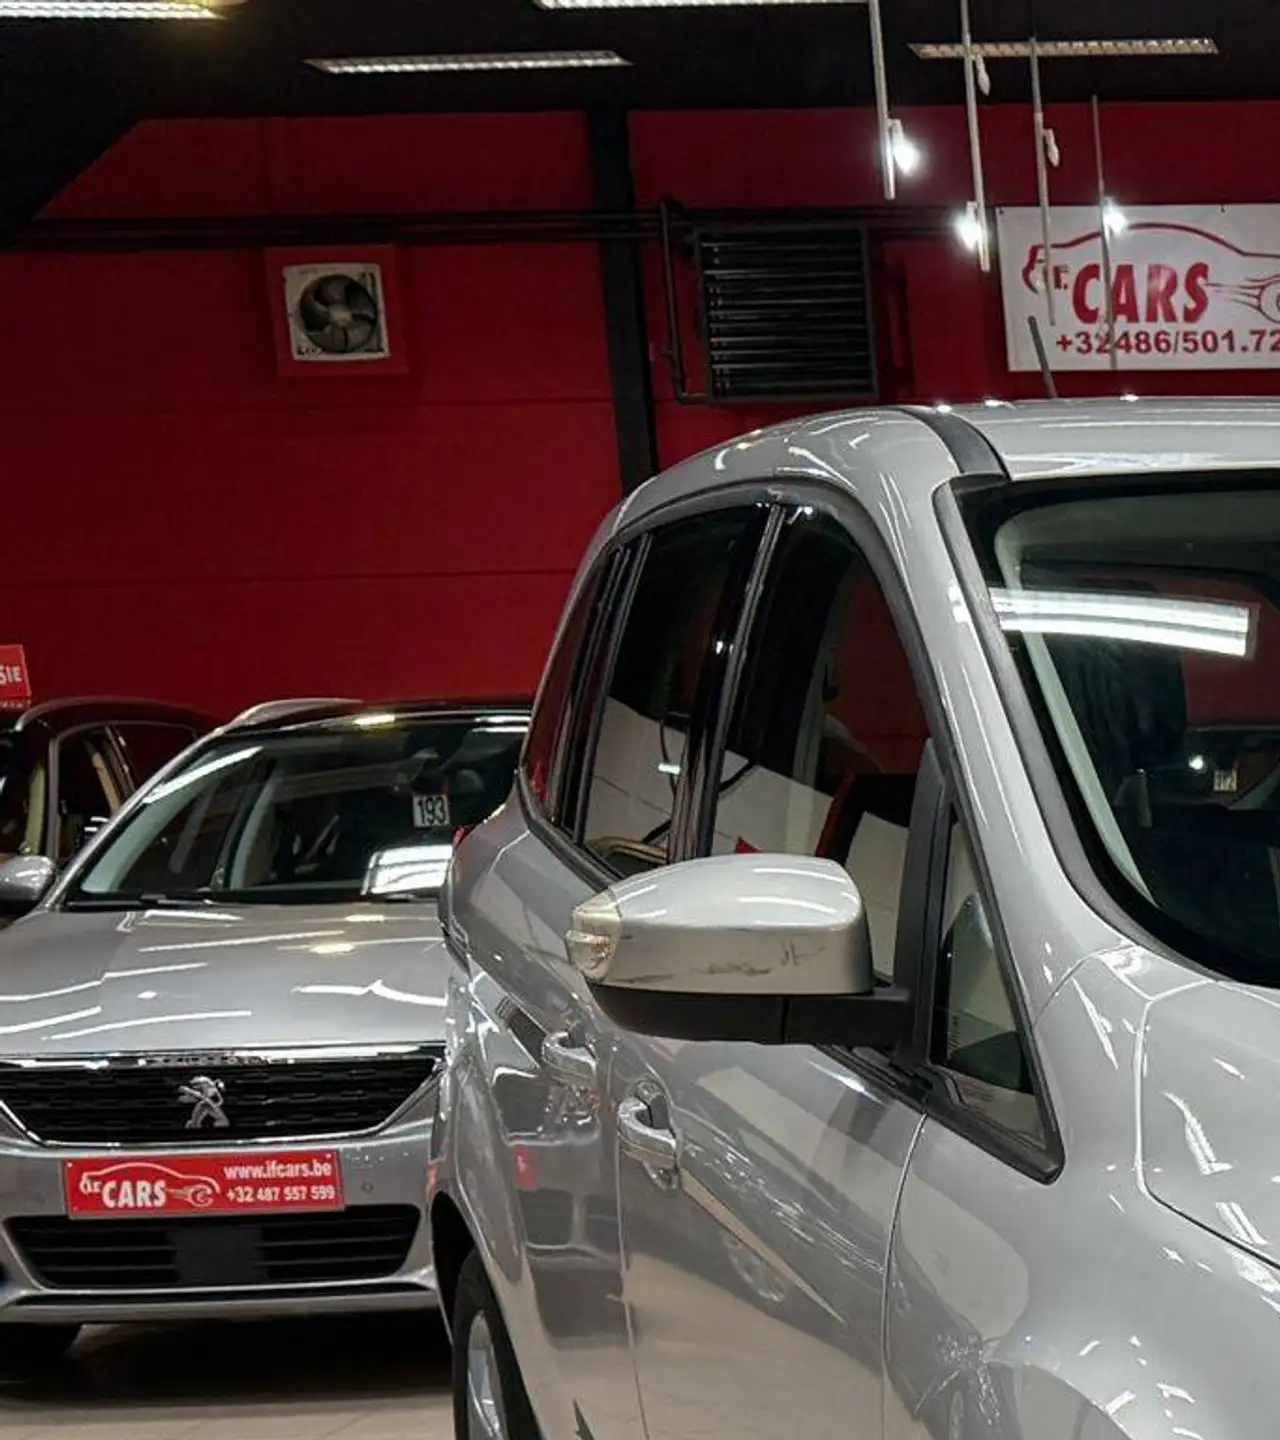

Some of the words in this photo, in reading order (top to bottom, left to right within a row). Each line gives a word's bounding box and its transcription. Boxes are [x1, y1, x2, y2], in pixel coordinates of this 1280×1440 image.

[1072, 262, 1209, 324] CARS
[417, 796, 446, 823] 193
[223, 1160, 333, 1180] www.ifcars.be
[102, 1179, 166, 1208] CARS
[226, 1185, 255, 1203] +32
[256, 1185, 281, 1201] 487
